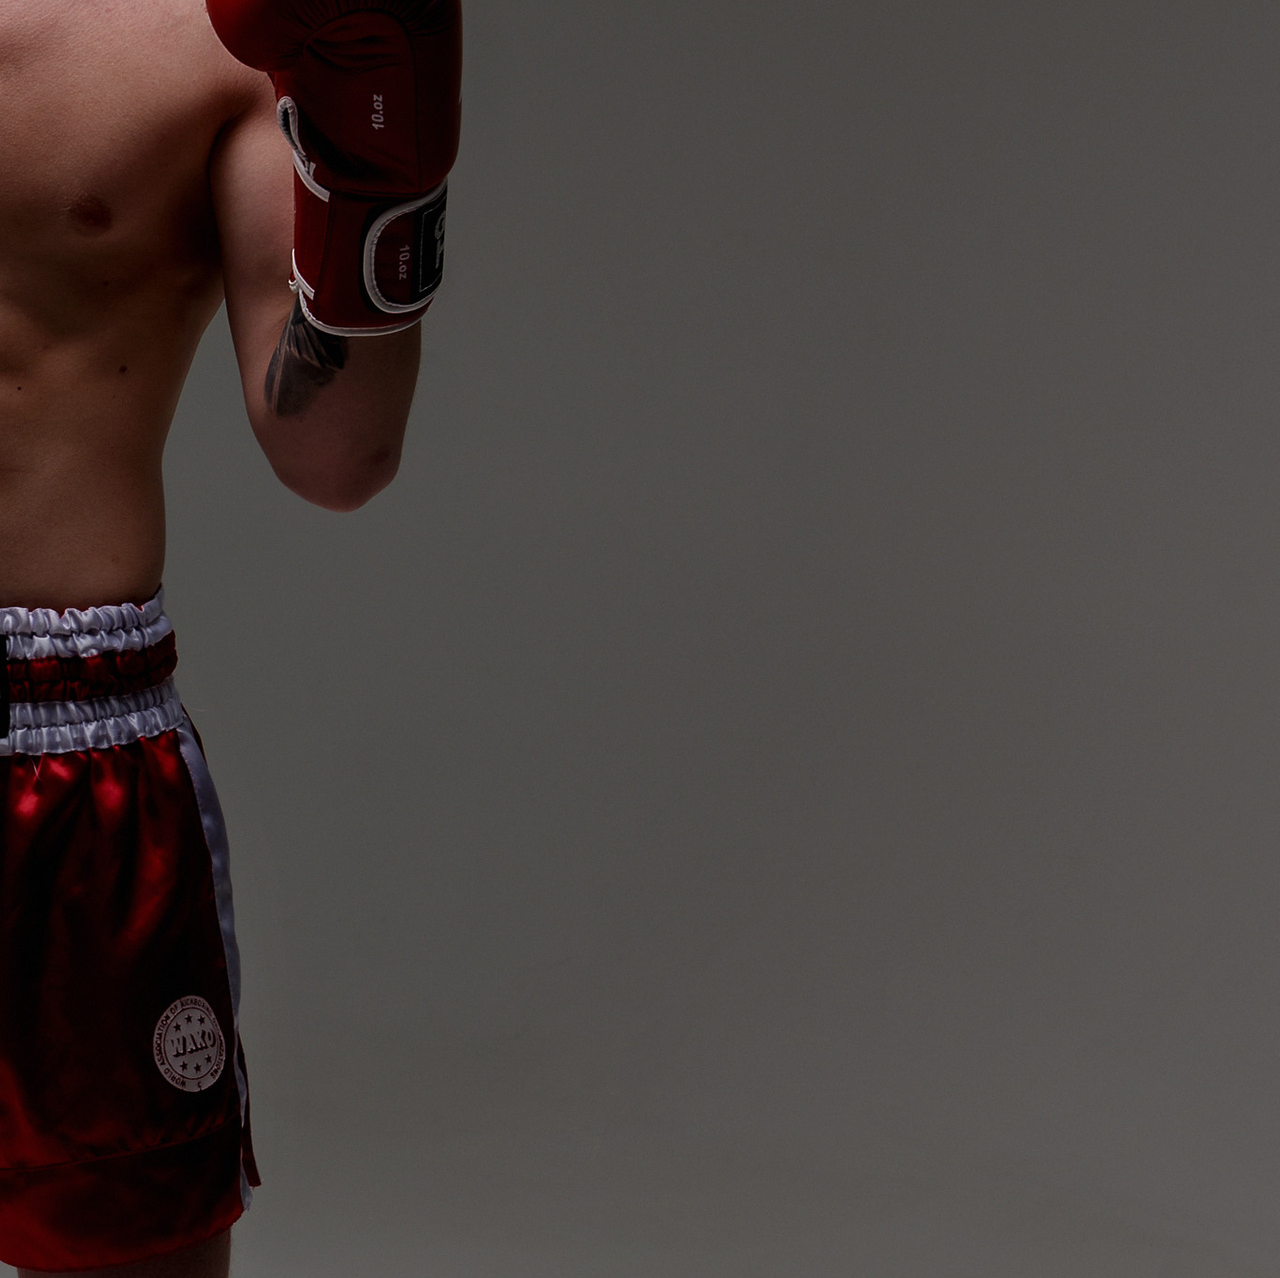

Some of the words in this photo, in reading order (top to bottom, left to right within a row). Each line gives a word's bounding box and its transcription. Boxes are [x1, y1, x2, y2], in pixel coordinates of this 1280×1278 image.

[371, 94, 385, 130] 10.oz
[398, 244, 411, 281] 10.oz
[170, 1029, 217, 1058] WAKO
[163, 1067, 187, 1088] WORLD
